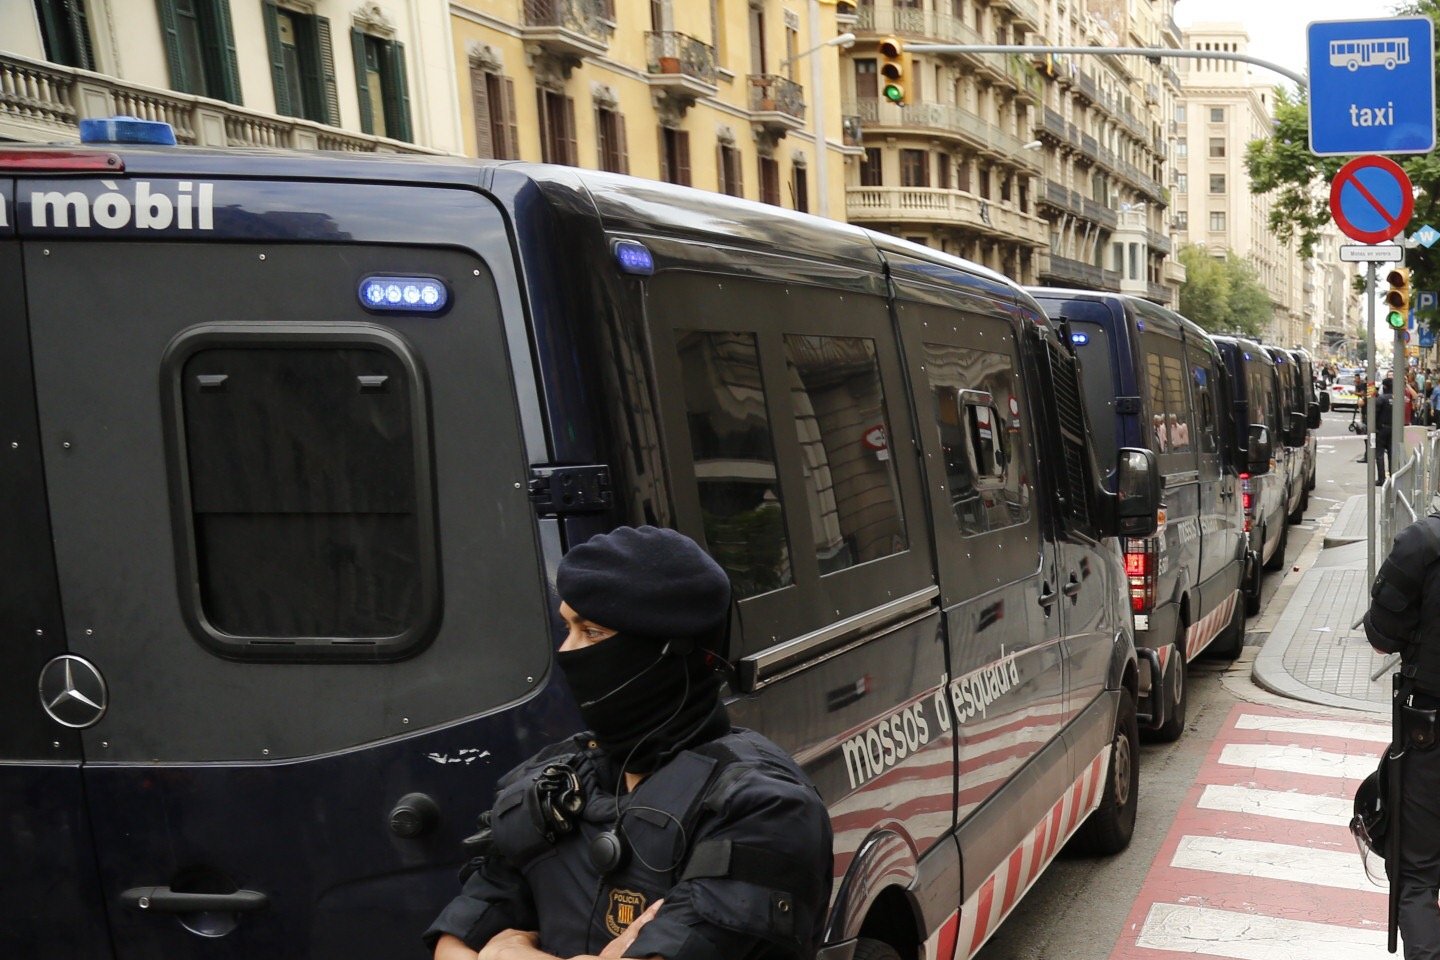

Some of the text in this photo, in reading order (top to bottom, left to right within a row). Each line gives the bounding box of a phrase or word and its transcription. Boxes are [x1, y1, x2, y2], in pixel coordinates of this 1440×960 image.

[1350, 101, 1394, 127] taxi
[31, 180, 214, 230] mòbil
[1421, 293, 1434, 309] P
[842, 701, 930, 789] mossos
[613, 893, 640, 905] POLICIA
